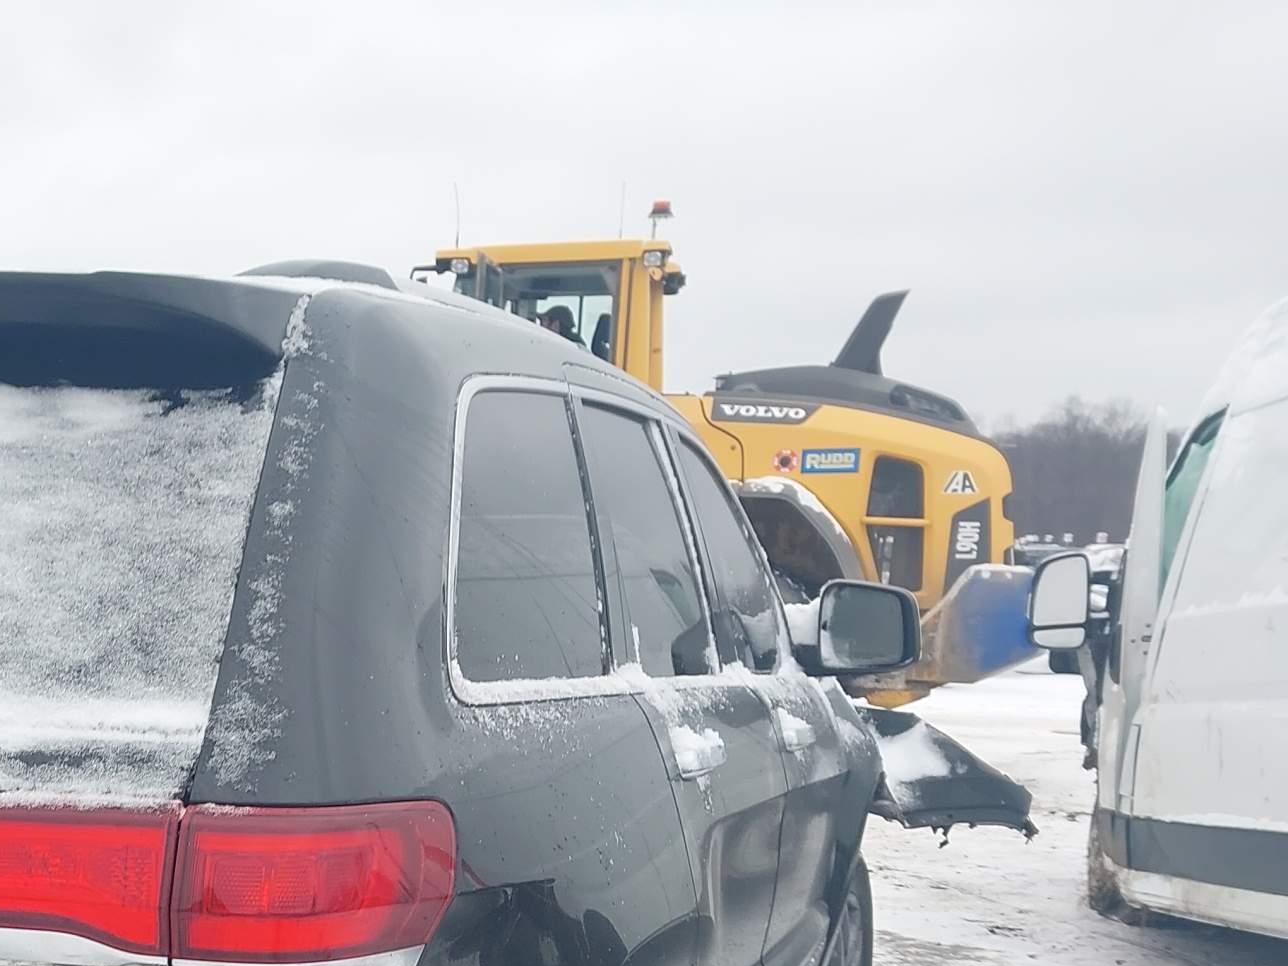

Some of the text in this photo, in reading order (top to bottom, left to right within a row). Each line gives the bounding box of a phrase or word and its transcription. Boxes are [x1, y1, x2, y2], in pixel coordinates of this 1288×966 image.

[719, 403, 807, 419] VOLVO
[805, 452, 856, 470] RUDD
[954, 520, 982, 560] L90H
